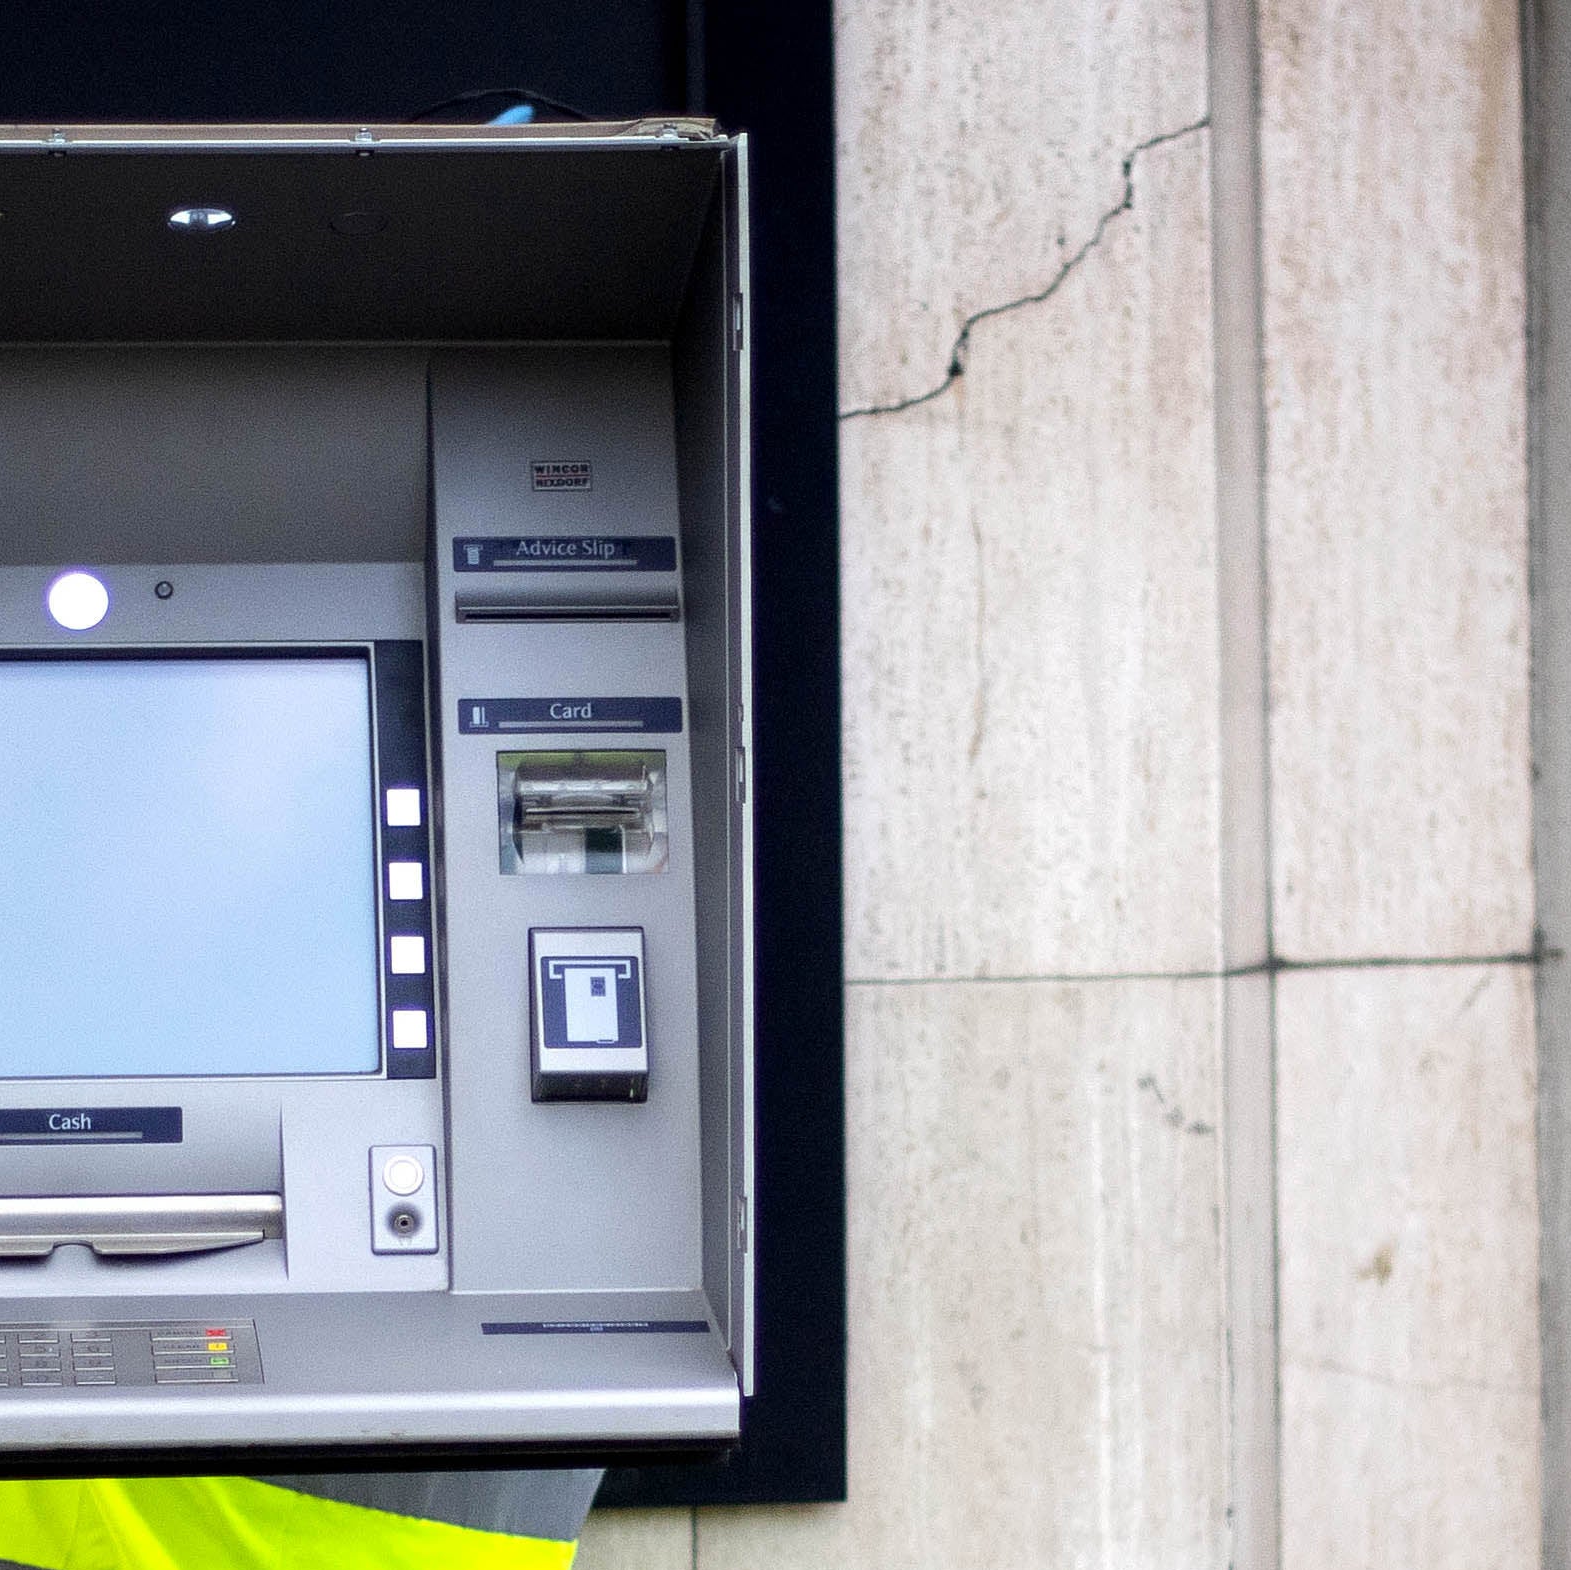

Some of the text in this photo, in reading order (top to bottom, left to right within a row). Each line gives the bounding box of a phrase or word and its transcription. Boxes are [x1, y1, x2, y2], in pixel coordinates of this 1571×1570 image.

[534, 464, 588, 473] WINCOR
[516, 540, 615, 560] Advice Slip
[550, 702, 592, 719] Card
[48, 1113, 92, 1130] Cash
